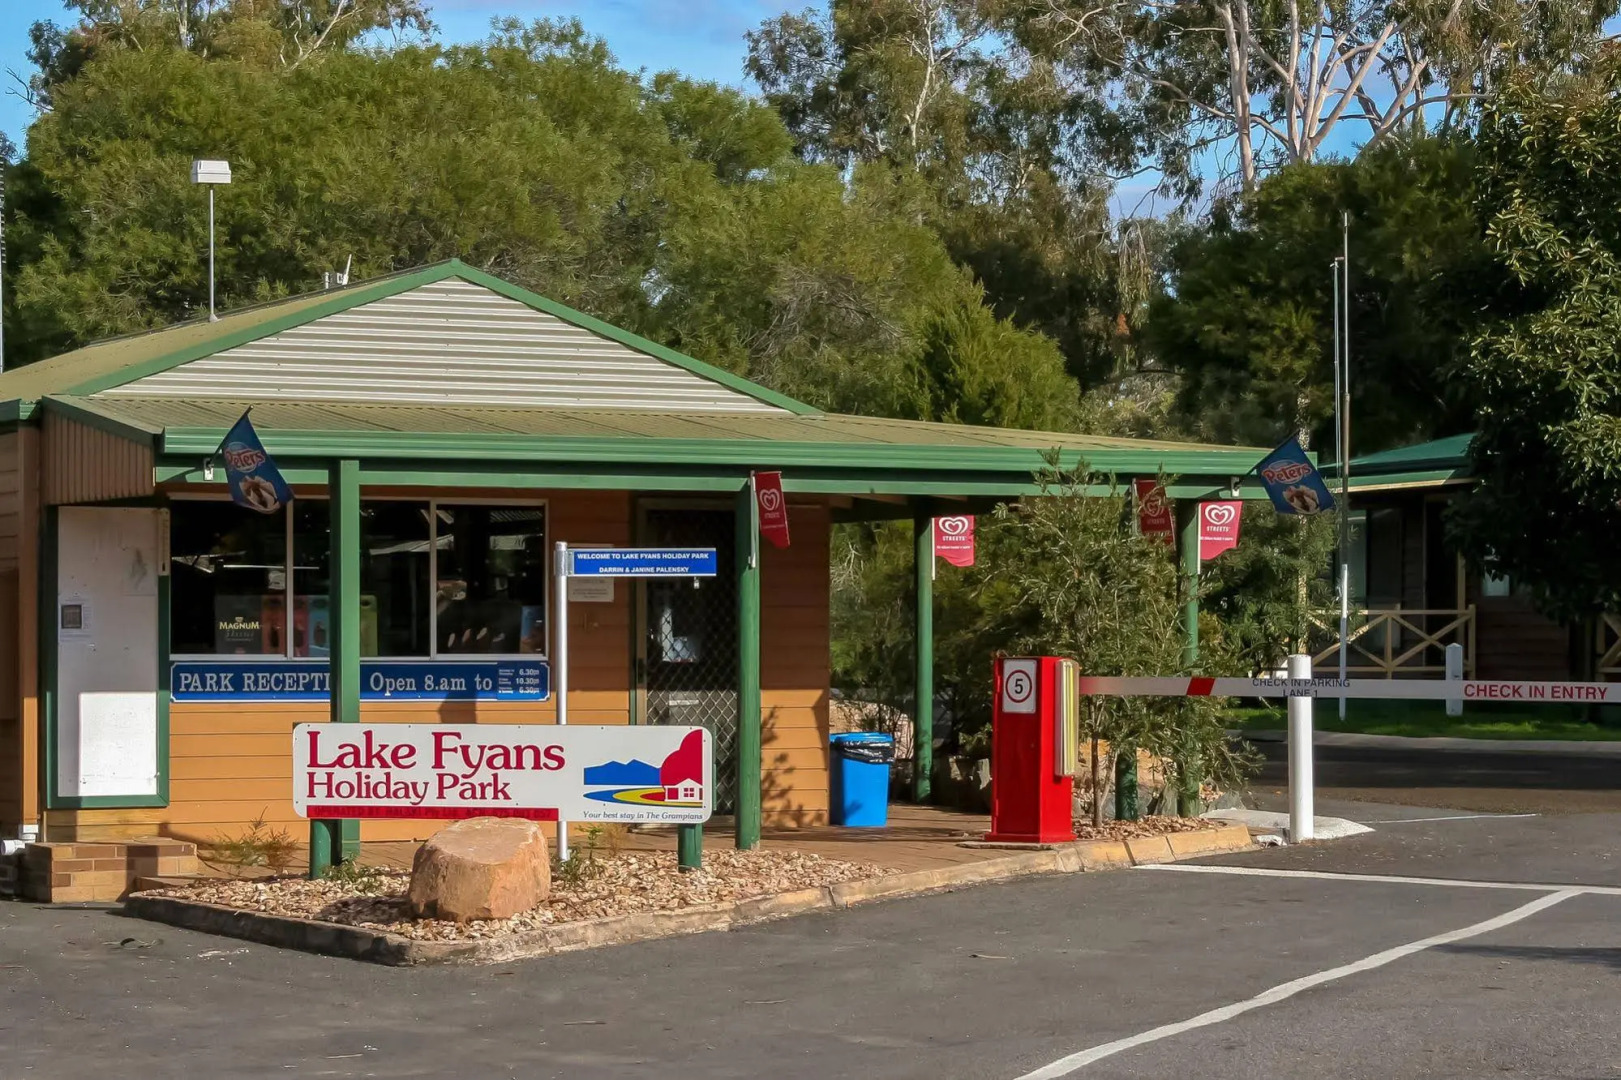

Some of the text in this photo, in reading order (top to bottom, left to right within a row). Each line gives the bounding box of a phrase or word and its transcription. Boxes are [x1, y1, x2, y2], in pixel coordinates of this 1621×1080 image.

[1262, 463, 1312, 484] Peters
[219, 621, 260, 630] MAGNUM
[179, 672, 331, 692] PARK RECEPTI
[370, 672, 493, 697] Open 8.am to
[1014, 678, 1024, 694] 5
[1252, 678, 1351, 688] CHECK IN PARKING
[1282, 688, 1318, 698] LANE 1
[1464, 683, 1608, 700] CHECK IN ENTRY
[307, 730, 566, 779] Lake Fyans
[307, 771, 513, 806] Holiday Park
[583, 811, 703, 821] Your best stay in The Grampians
